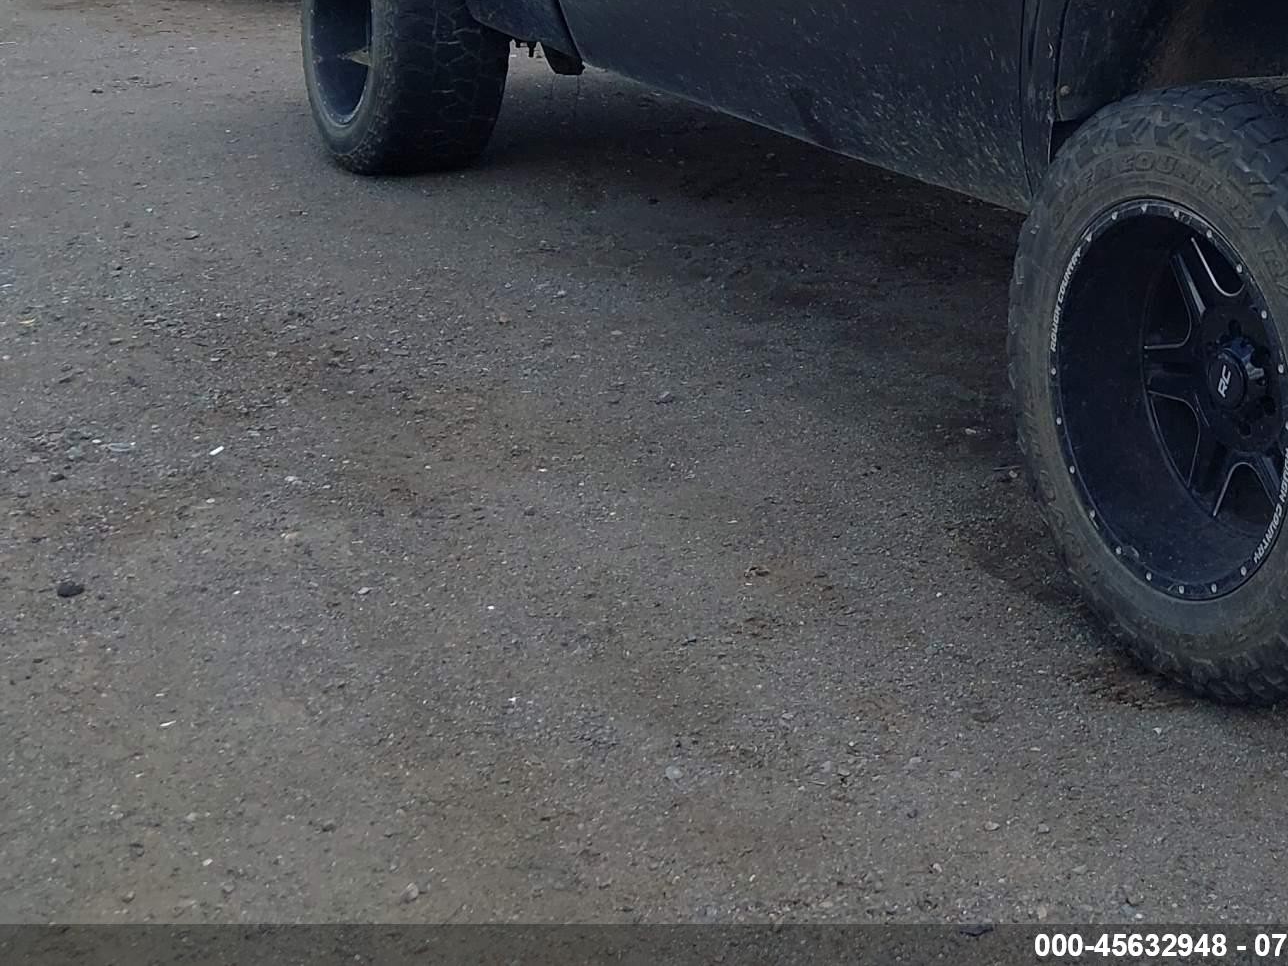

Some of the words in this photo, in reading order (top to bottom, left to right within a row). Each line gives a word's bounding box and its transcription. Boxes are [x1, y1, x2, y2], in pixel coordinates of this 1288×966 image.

[1050, 301, 1062, 353] ROUGH
[1058, 245, 1081, 303] COUNTRY
[1217, 364, 1231, 398] RC
[1253, 503, 1283, 564] COUNTRY
